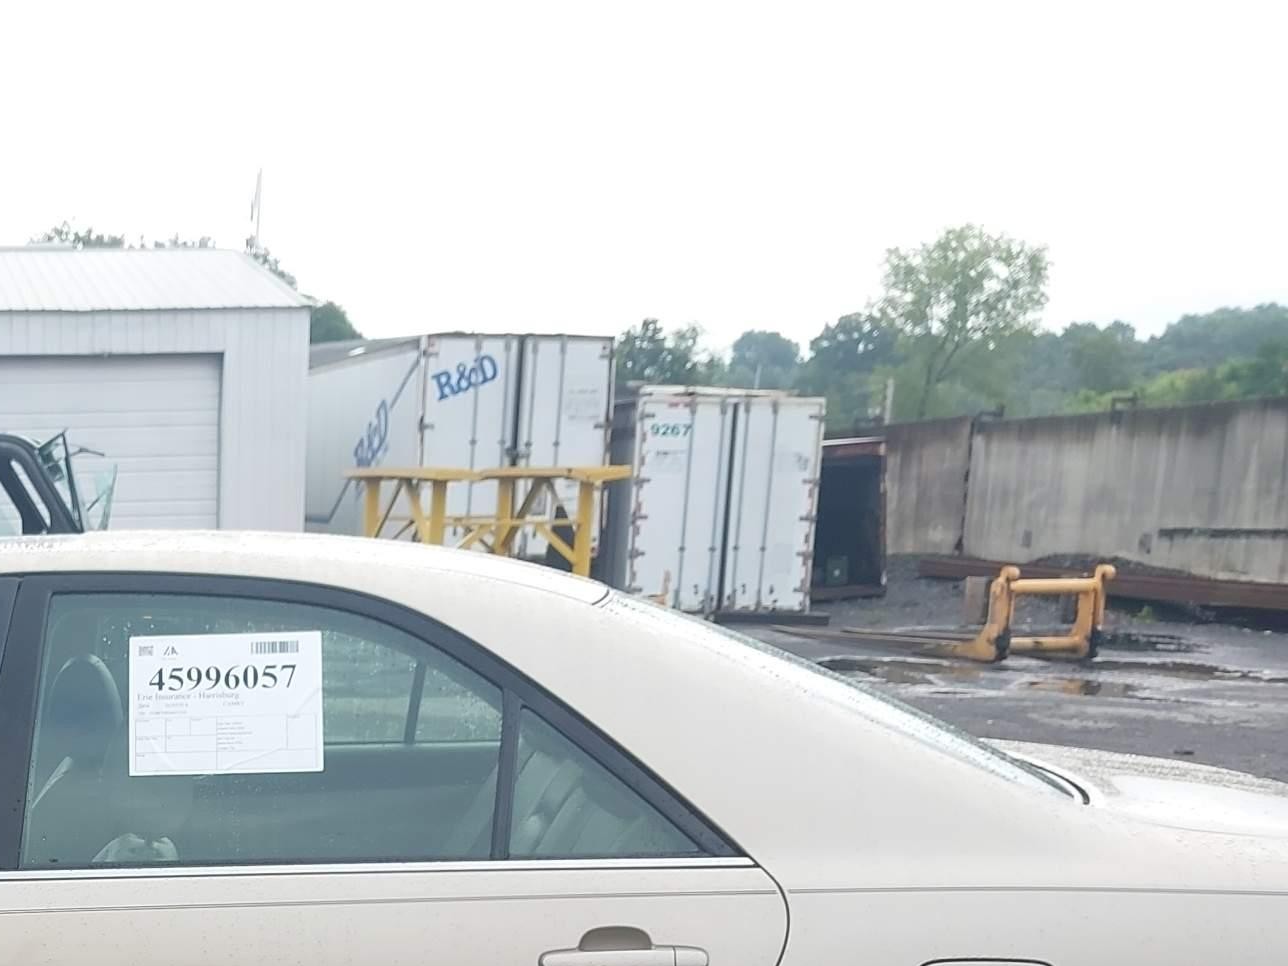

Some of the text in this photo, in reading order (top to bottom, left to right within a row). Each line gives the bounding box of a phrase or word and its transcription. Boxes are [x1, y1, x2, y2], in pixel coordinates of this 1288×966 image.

[432, 355, 497, 401] R&D
[651, 423, 692, 437] 9267
[149, 664, 297, 692] 45996057
